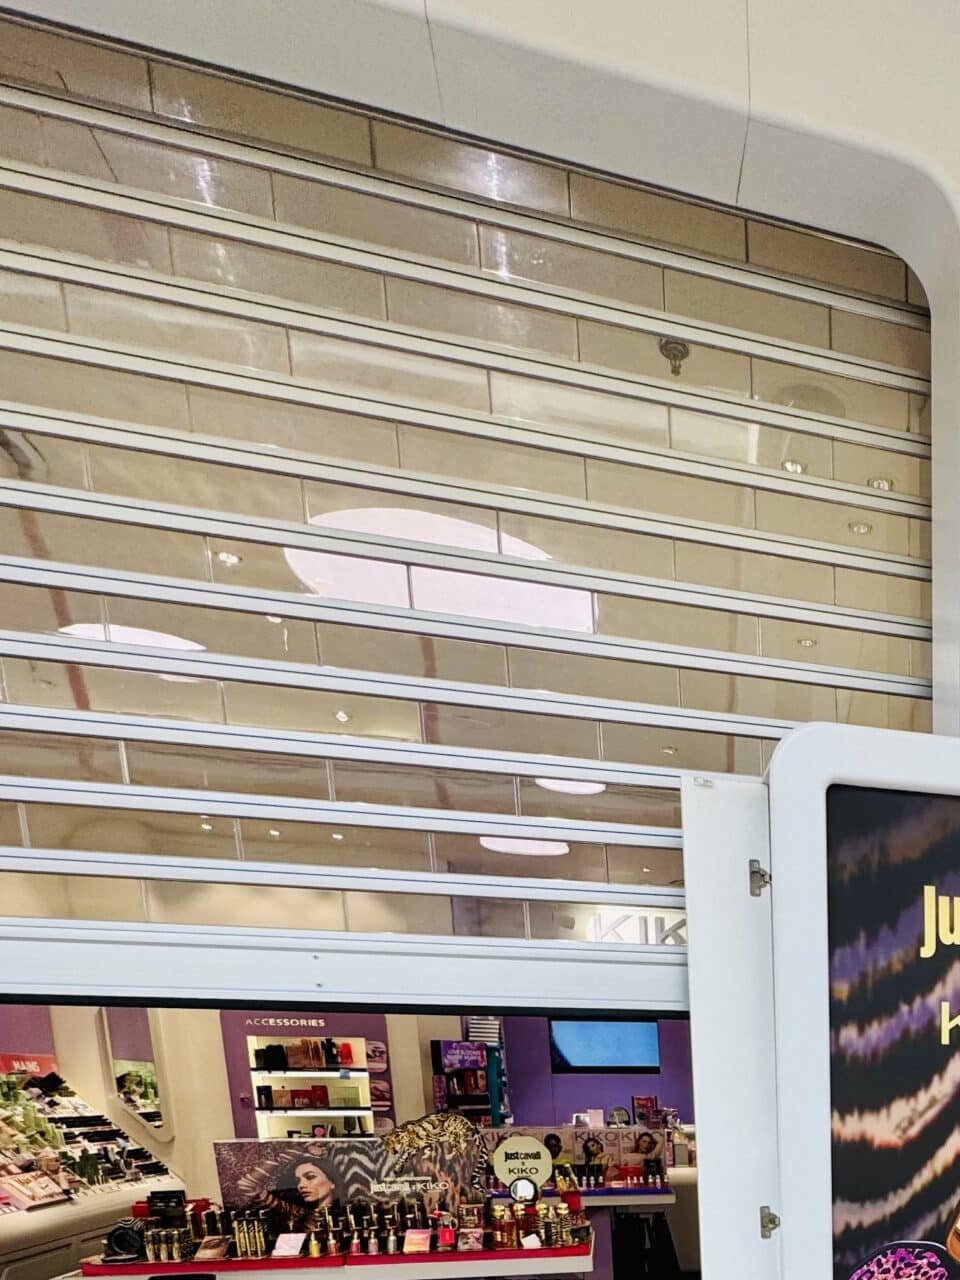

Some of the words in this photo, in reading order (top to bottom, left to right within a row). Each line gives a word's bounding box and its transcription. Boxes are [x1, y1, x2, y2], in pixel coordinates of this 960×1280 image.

[593, 911, 687, 945] KIK
[245, 1017, 326, 1028] ACCESSORIES
[508, 1167, 539, 1175] KIKO
